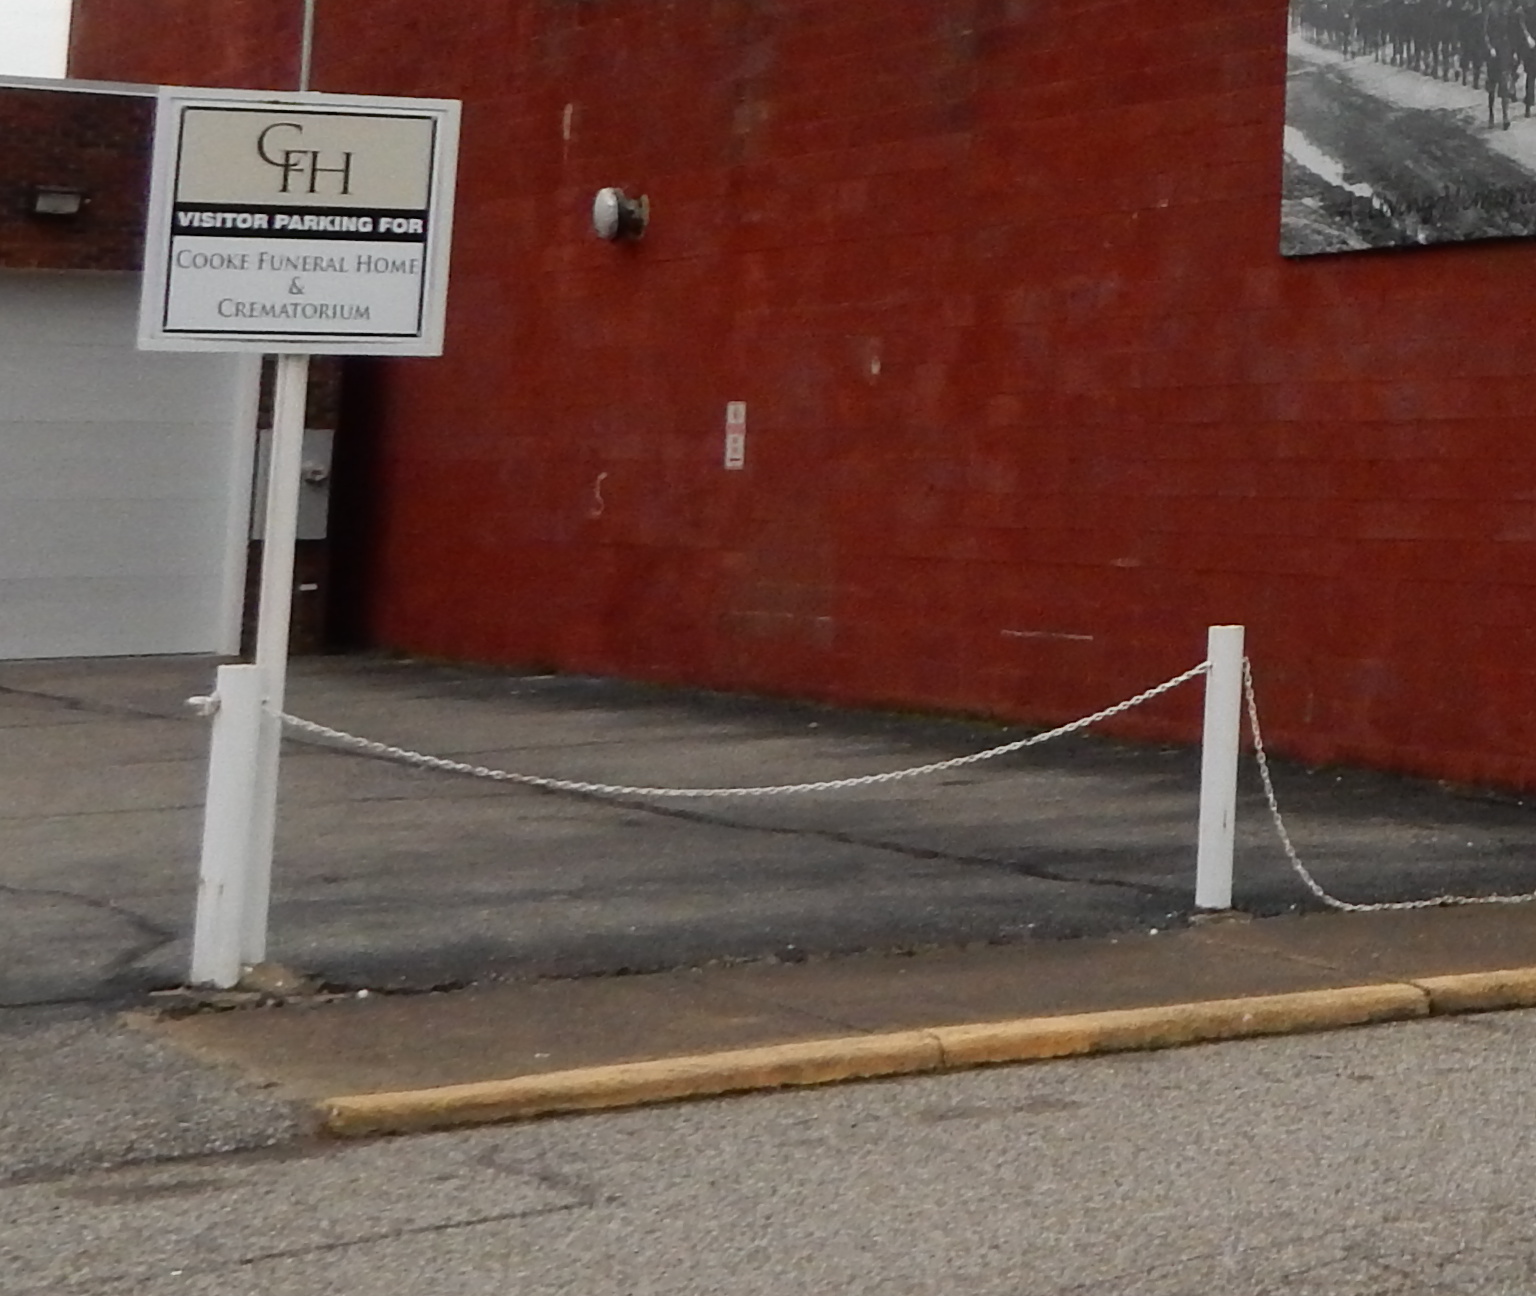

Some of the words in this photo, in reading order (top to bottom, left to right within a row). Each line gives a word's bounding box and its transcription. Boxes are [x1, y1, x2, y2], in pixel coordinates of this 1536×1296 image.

[257, 122, 354, 195] CFH
[177, 211, 268, 229] VISITOR
[274, 214, 373, 232] PARKING
[378, 217, 424, 234] FOR
[176, 249, 249, 271] COOKE
[257, 251, 349, 273] FUNERAL
[356, 255, 419, 275] HOME
[288, 276, 305, 295] &
[217, 298, 371, 320] CREMATORIUM
